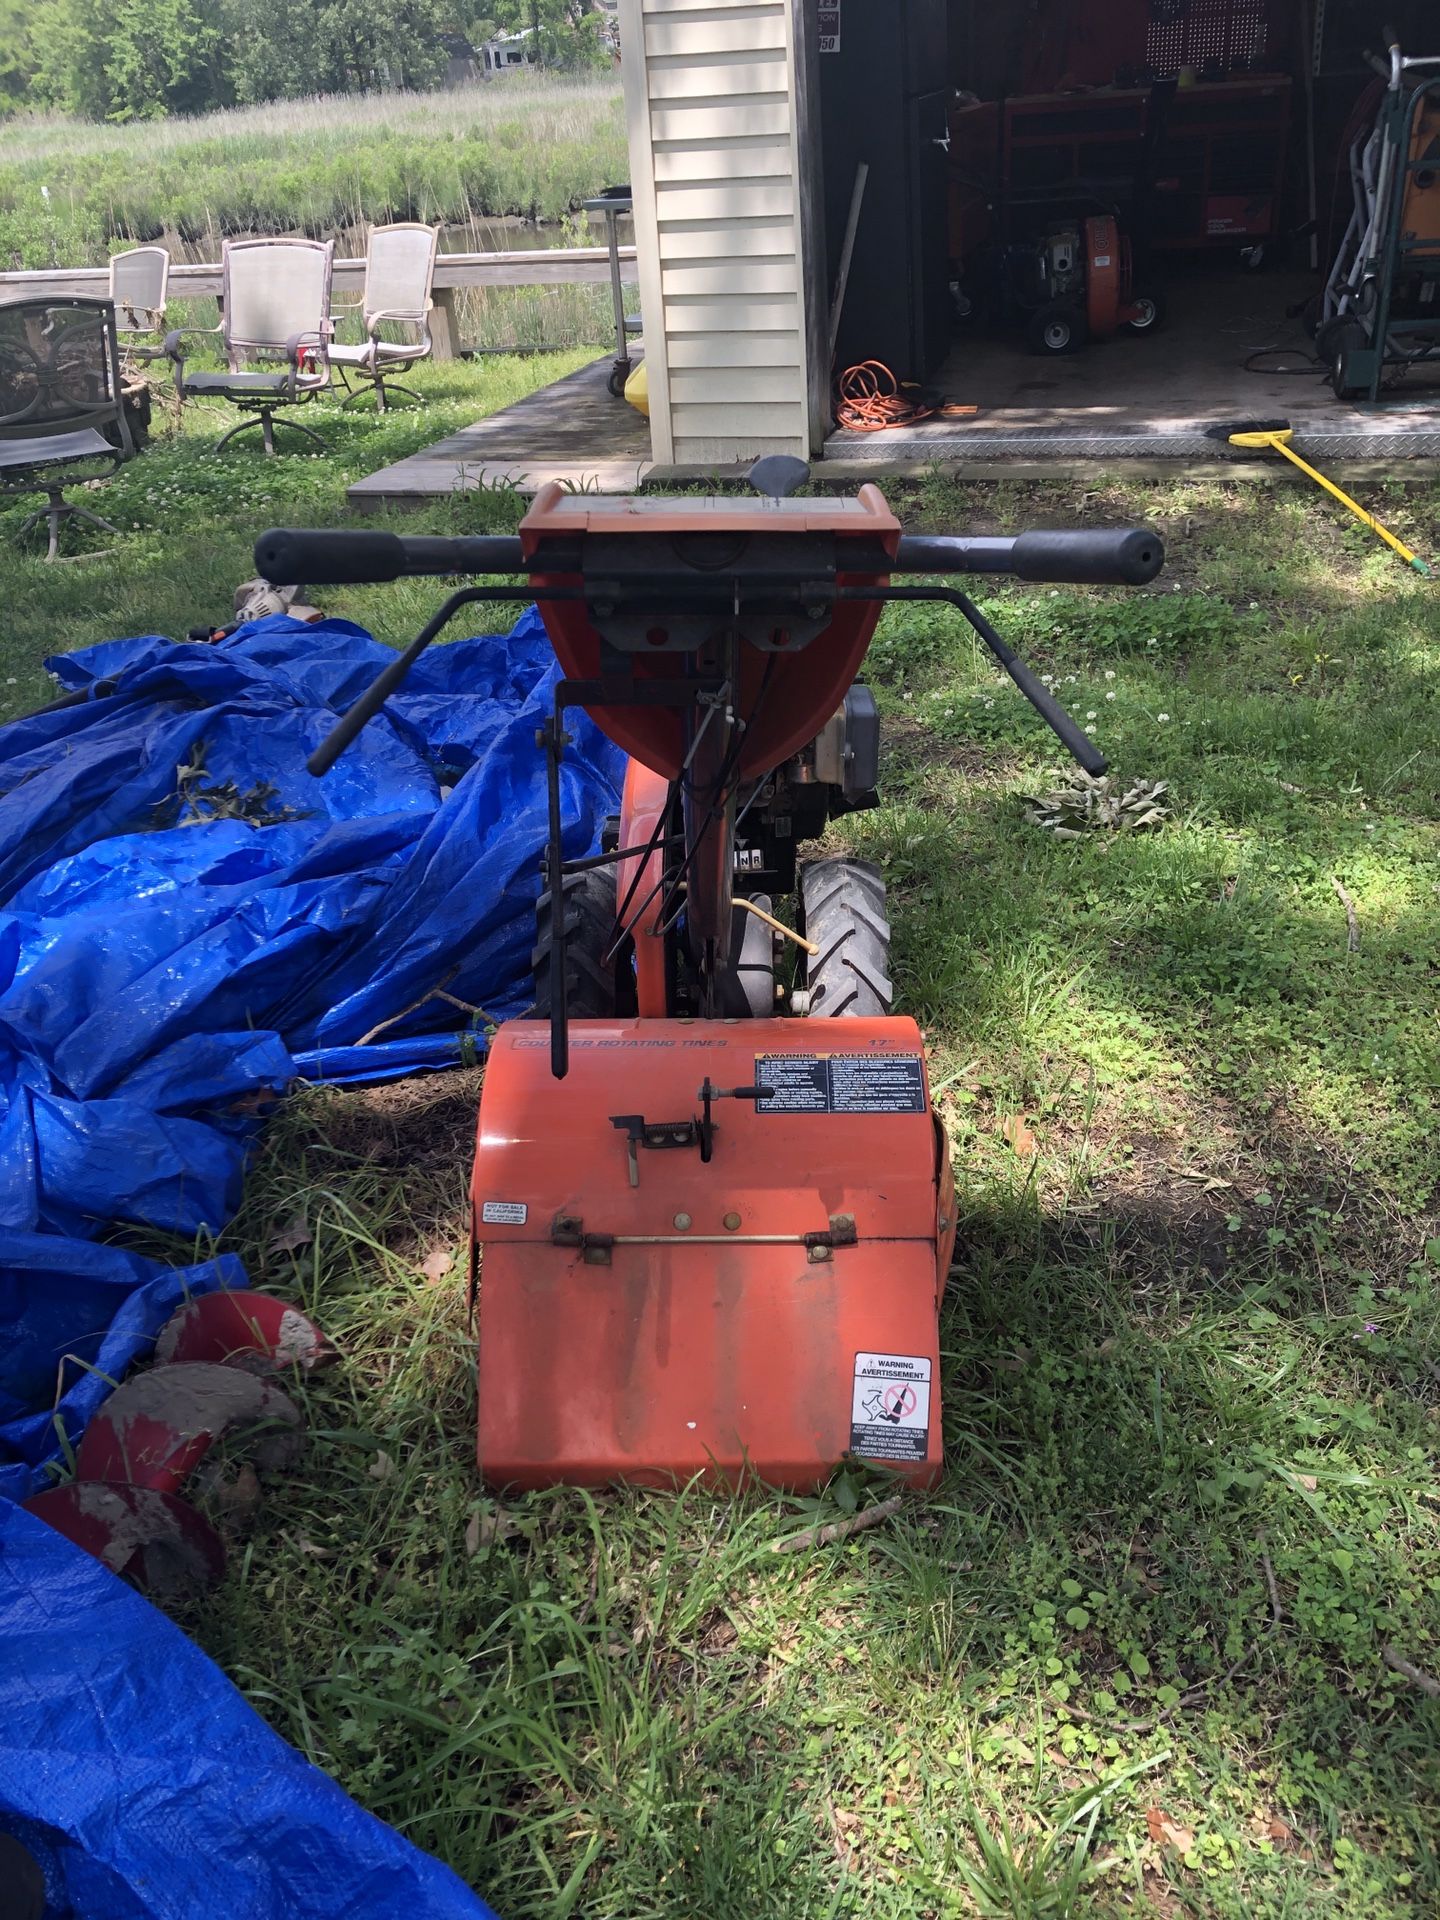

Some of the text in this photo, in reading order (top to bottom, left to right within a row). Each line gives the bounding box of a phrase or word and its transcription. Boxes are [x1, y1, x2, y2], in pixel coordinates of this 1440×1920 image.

[741, 857, 748, 865] N
[518, 1040, 593, 1048] COUTER
[878, 1360, 914, 1369] WARNING
[862, 1368, 924, 1379] AVERTISSEMENT
